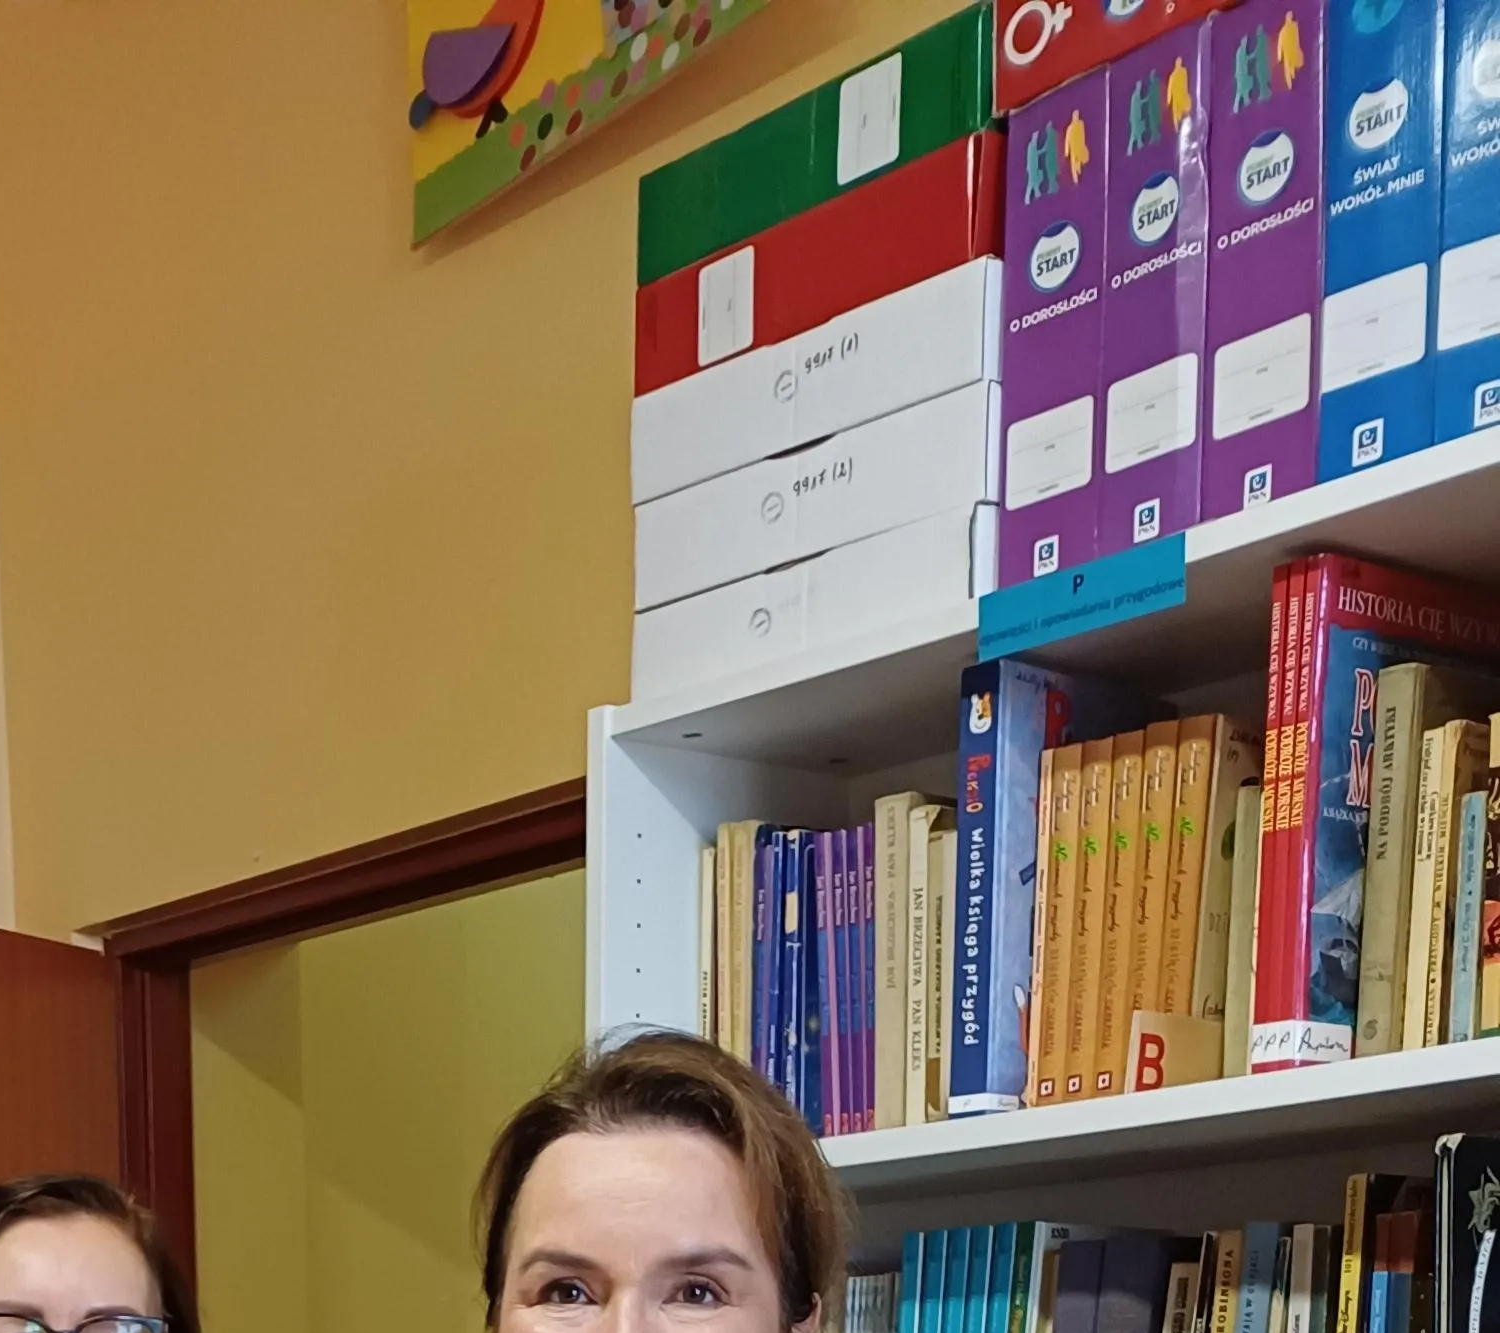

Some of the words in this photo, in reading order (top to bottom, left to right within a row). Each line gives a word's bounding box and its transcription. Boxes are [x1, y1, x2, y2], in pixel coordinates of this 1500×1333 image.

[1245, 157, 1291, 190] START
[1329, 187, 1385, 217] WOKÓŁ
[1386, 169, 1425, 195] MNIE
[1136, 197, 1177, 231] START
[1217, 233, 1227, 250] O
[1229, 197, 1315, 246] DOROSŁOŚCI
[1036, 248, 1077, 277] START
[1111, 275, 1122, 290] O
[1123, 242, 1203, 284] DOROSŁOŚCI
[1009, 319, 1021, 334] O
[1021, 287, 1098, 330] DOROSŁOŚCI
[1072, 574, 1085, 595] P
[1113, 575, 1185, 615] przygodowe
[1338, 586, 1416, 627] HISTORIA
[1418, 602, 1447, 637] CIĘ
[912, 887, 924, 912] JAN
[966, 895, 987, 958] księga
[911, 999, 922, 1025] PAN
[961, 963, 980, 1046] przygód
[1135, 1032, 1165, 1092] B
